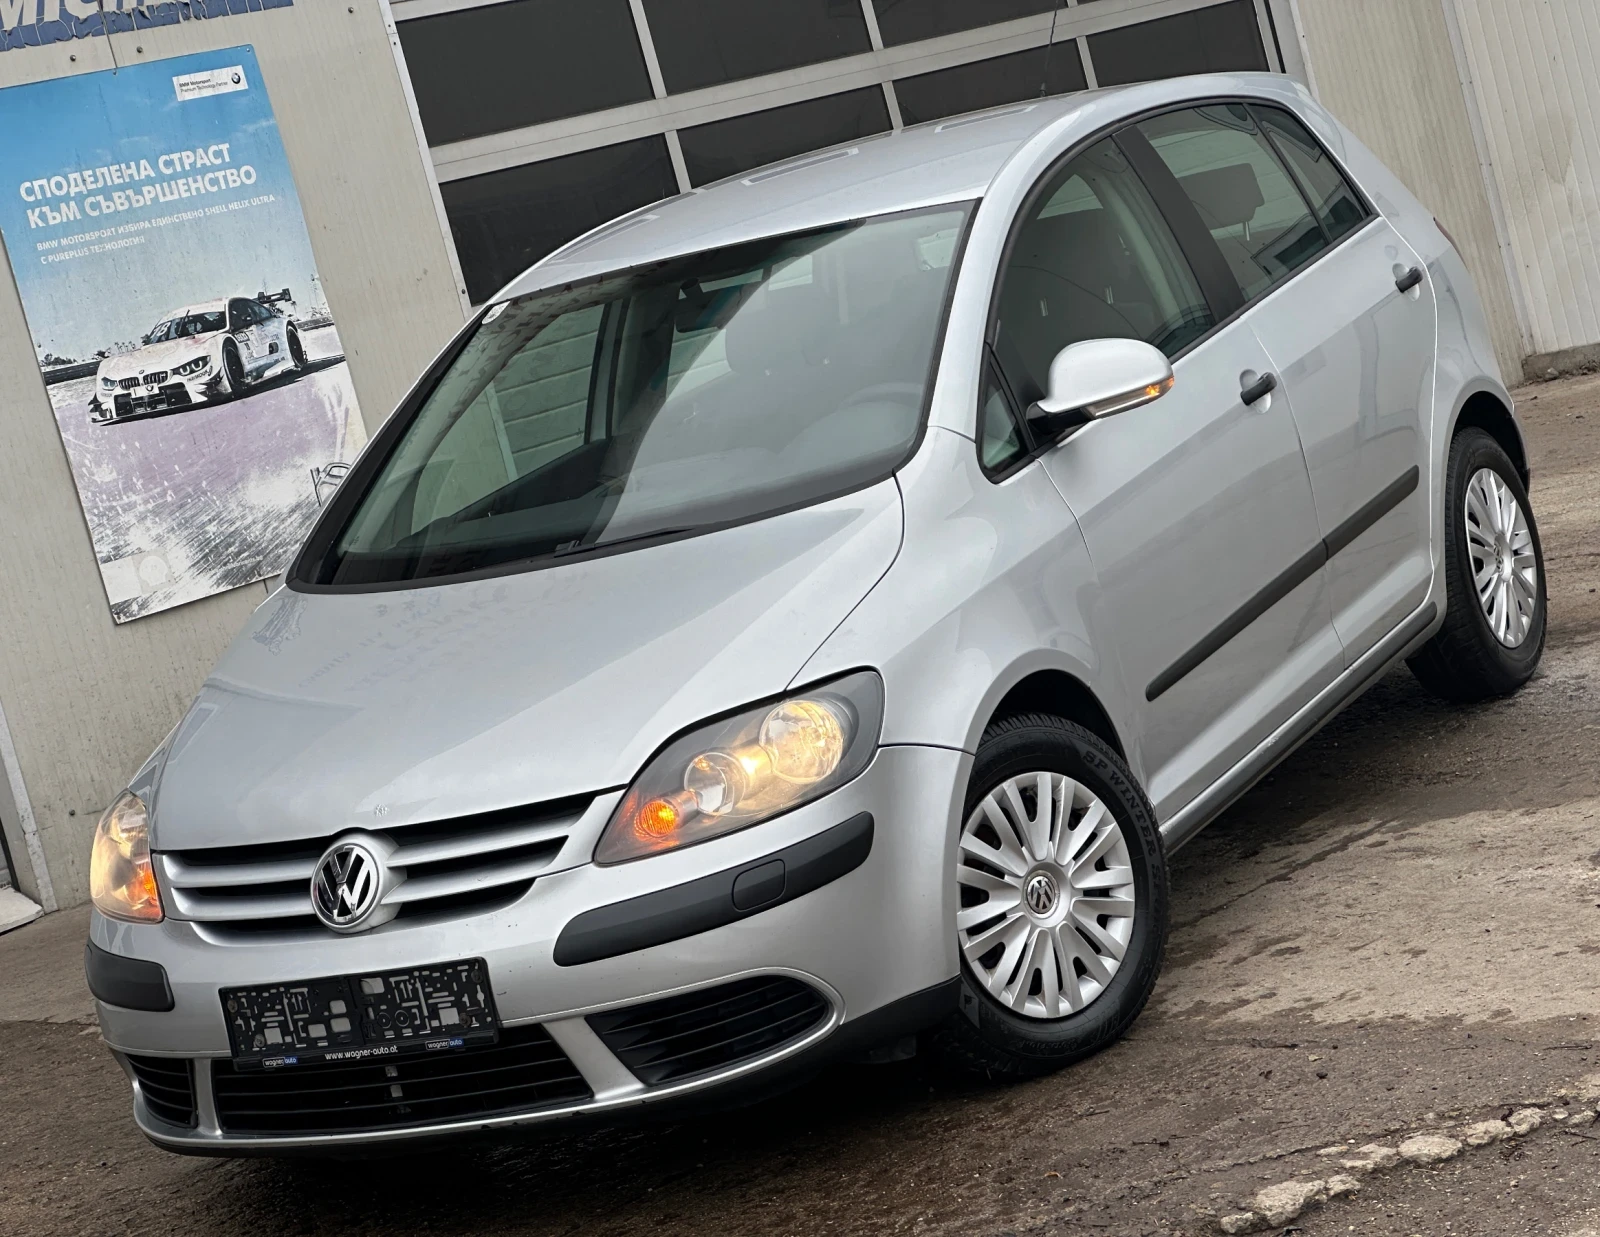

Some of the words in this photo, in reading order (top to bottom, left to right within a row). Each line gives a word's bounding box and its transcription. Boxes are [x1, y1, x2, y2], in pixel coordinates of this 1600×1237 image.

[19, 159, 156, 202] СПОДЕЛЕНА
[158, 143, 231, 175] СТРАСТ
[26, 200, 82, 229] КЪМ
[84, 165, 257, 217] СЪВЪРШЕНСТВО
[36, 239, 58, 251] BMW
[60, 227, 116, 246] MOTORSPORT
[117, 220, 151, 234] ИЗБИРА
[151, 209, 204, 227] ЕДИНСТВЕНО
[205, 204, 228, 216] SHELL
[228, 199, 250, 211] HELIX
[251, 194, 275, 206] ULTRA
[48, 247, 89, 263] PUREPLUS
[90, 235, 145, 253] ТЕХНОЛОГИЯ
[1083, 750, 1109, 771] SP
[1109, 770, 1157, 857] WINTER
[325, 1045, 398, 1060] www.wagner-auto.at
